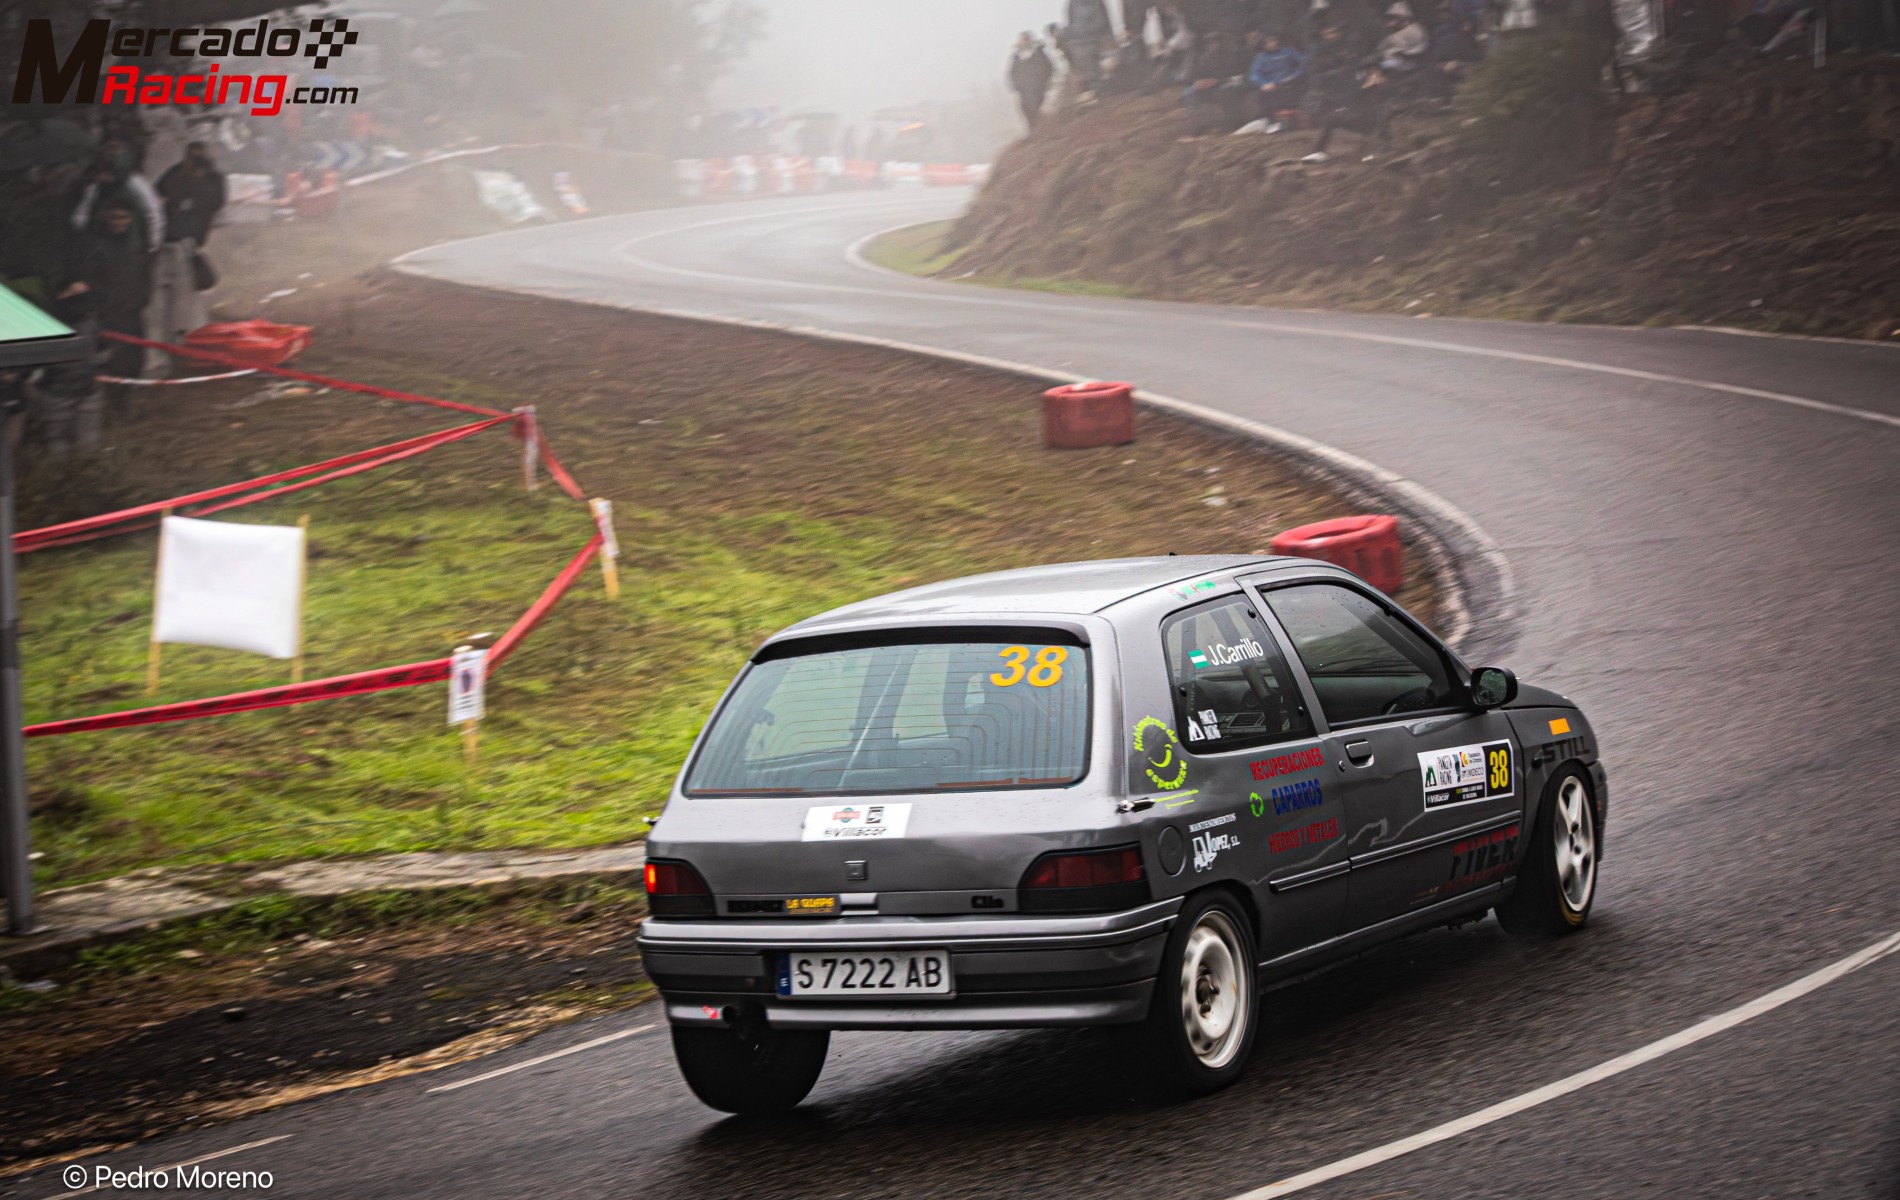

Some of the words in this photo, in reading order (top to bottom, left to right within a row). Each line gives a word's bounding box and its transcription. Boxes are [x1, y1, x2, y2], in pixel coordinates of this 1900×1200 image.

[990, 645, 1068, 687] 38
[1208, 638, 1264, 666] J.Carrillo
[1249, 747, 1325, 781] RECUPERACIONES
[1541, 736, 1591, 763] STILL
[1489, 750, 1508, 789] 38
[797, 958, 814, 989] S
[821, 957, 897, 989] 7222
[904, 956, 943, 989] AB
